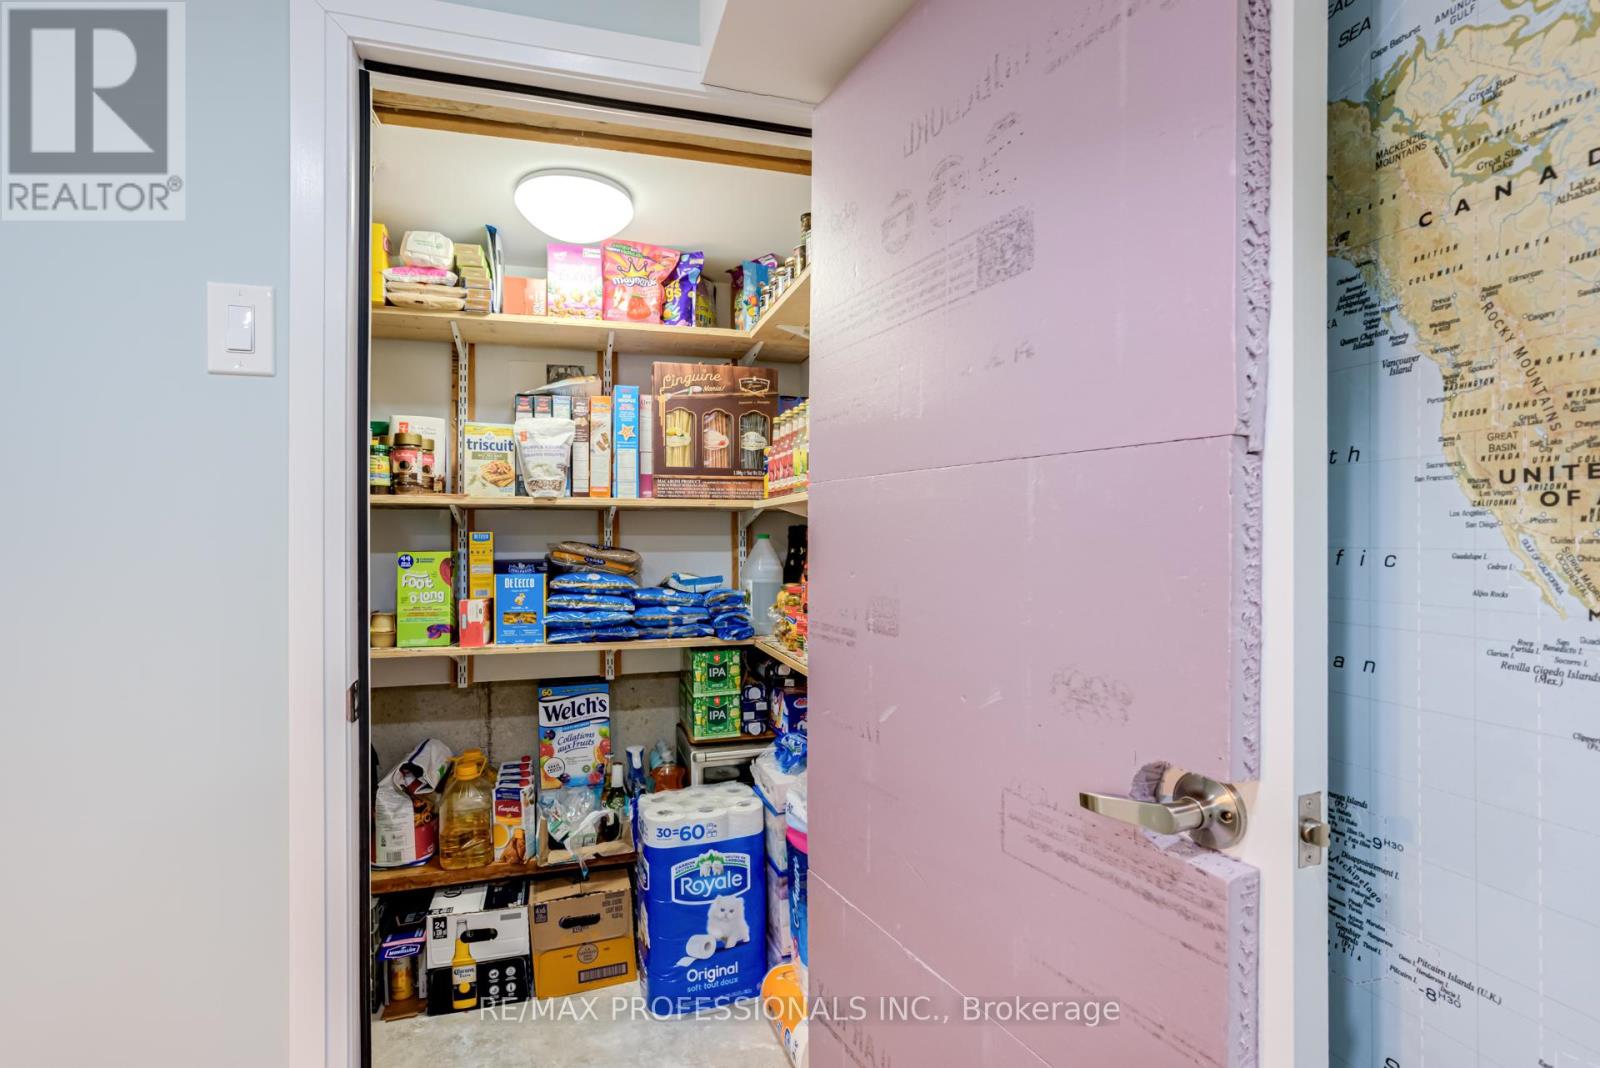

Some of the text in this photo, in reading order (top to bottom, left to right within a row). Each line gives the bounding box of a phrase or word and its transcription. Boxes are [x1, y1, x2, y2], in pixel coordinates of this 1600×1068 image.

[1449, 3, 1476, 25] GULF
[1338, 16, 1370, 48] SEA
[1370, 45, 1389, 60] Cape
[1376, 131, 1427, 160] MACKENZIE
[1376, 141, 1428, 171] MOUNTAINS
[1570, 177, 1595, 191] Lake
[1413, 243, 1459, 264] BRITISH
[1382, 355, 1421, 369] Vancouver
[1481, 301, 1516, 343] ROCKY
[1513, 346, 1562, 432] MOUNTAINS
[1389, 364, 1413, 377] Island
[1443, 377, 1495, 392] WASHINGTON
[1452, 408, 1488, 418] OREGON
[1501, 399, 1538, 412] IDAHO
[1487, 431, 1519, 442] GREAT
[467, 437, 515, 452] triscuit
[1488, 443, 1518, 454] BASIN
[1480, 453, 1520, 463] NEVADA
[1532, 455, 1561, 464] UTAH
[1527, 482, 1568, 492] ARIZONA
[1471, 499, 1517, 508] CALIFORNIA
[1540, 489, 1582, 507] OF
[709, 668, 727, 678] IPA
[1500, 660, 1531, 673] Revilla
[1532, 665, 1566, 678] Gigedo
[541, 688, 553, 697] 60
[542, 696, 608, 722] Welch's
[709, 710, 727, 720] IPA
[557, 731, 596, 746] Collations
[573, 738, 595, 750] Fruits
[681, 870, 743, 898] Royale
[434, 921, 446, 930] 24
[687, 961, 739, 987] Original
[1417, 957, 1446, 978] Pitcairn
[1446, 971, 1473, 992] Islands
[687, 977, 739, 994] soft tout doux
